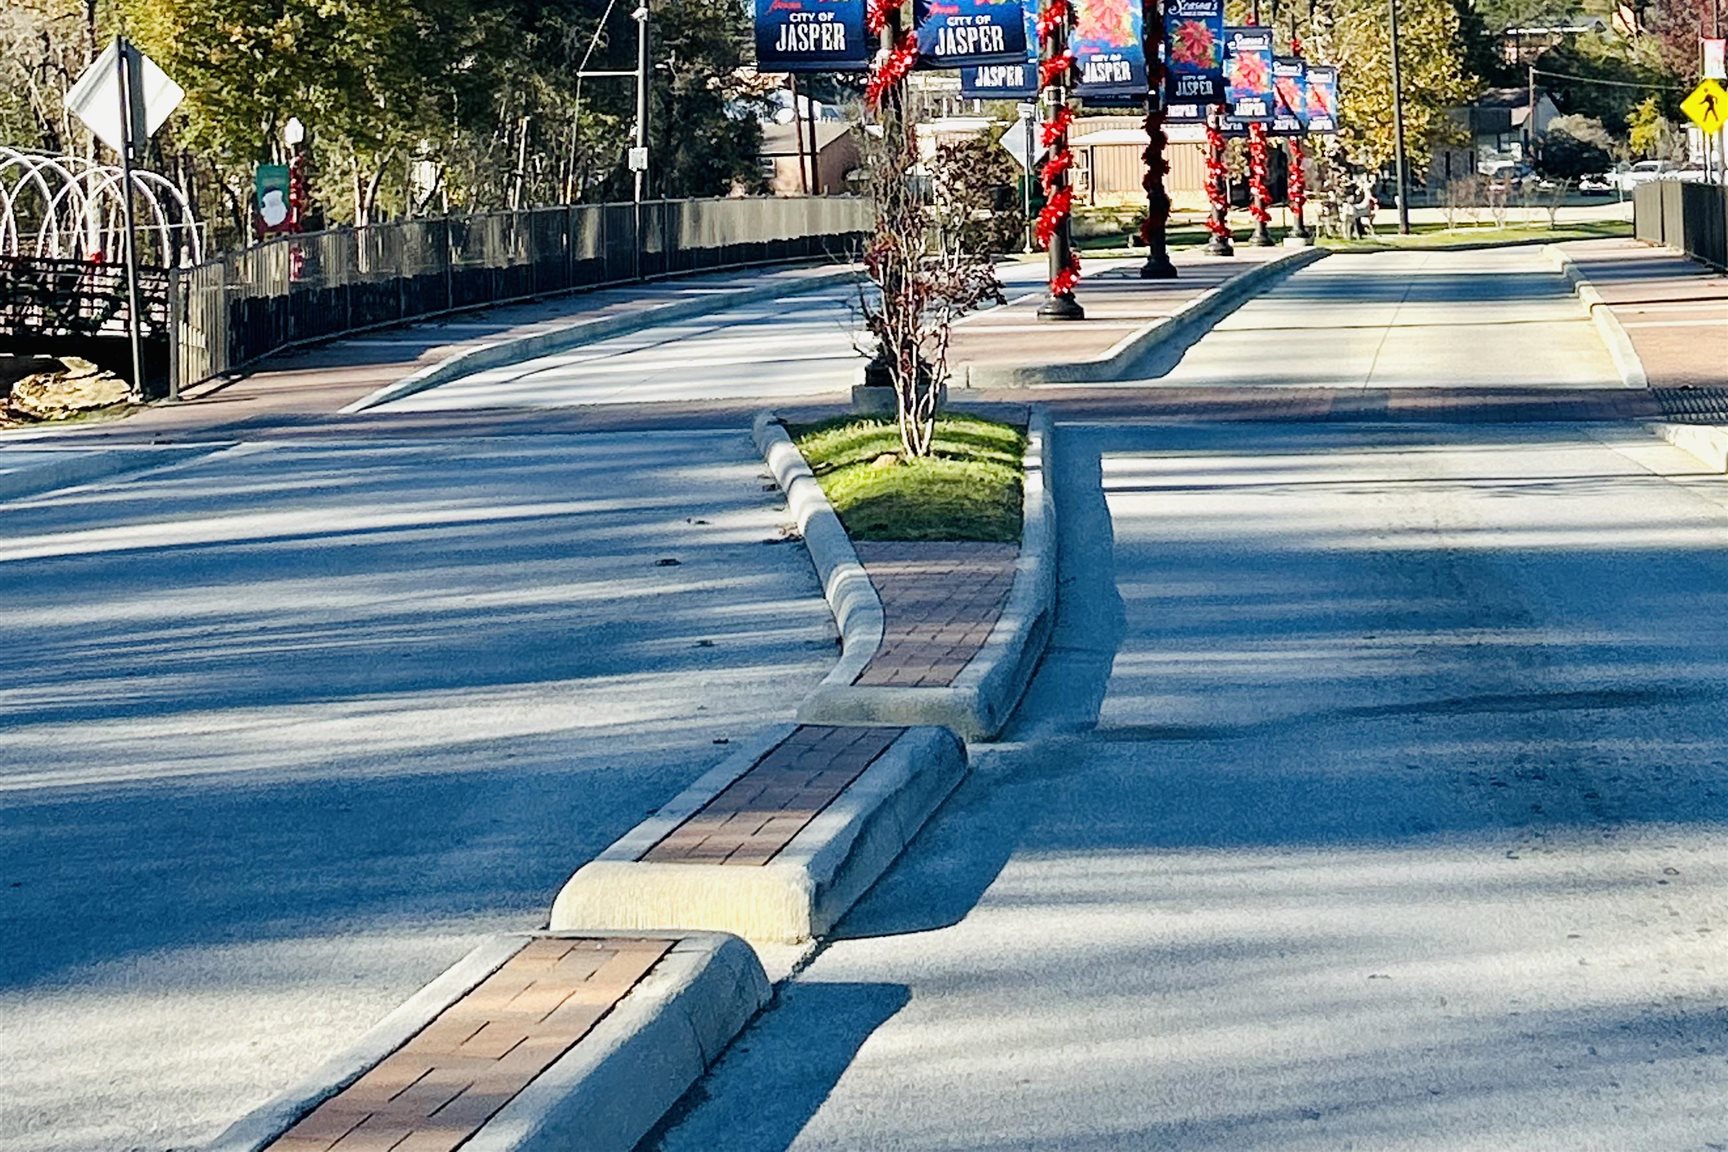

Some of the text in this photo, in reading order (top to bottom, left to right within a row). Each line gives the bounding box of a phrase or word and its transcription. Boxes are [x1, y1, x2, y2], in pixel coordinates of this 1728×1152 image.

[789, 11, 835, 22] CITY OF
[946, 15, 991, 26] CITY OF
[775, 23, 846, 51] JASPER
[934, 25, 1004, 56] JASPER
[974, 65, 1024, 87] JASPER
[1082, 60, 1132, 83] JASPER
